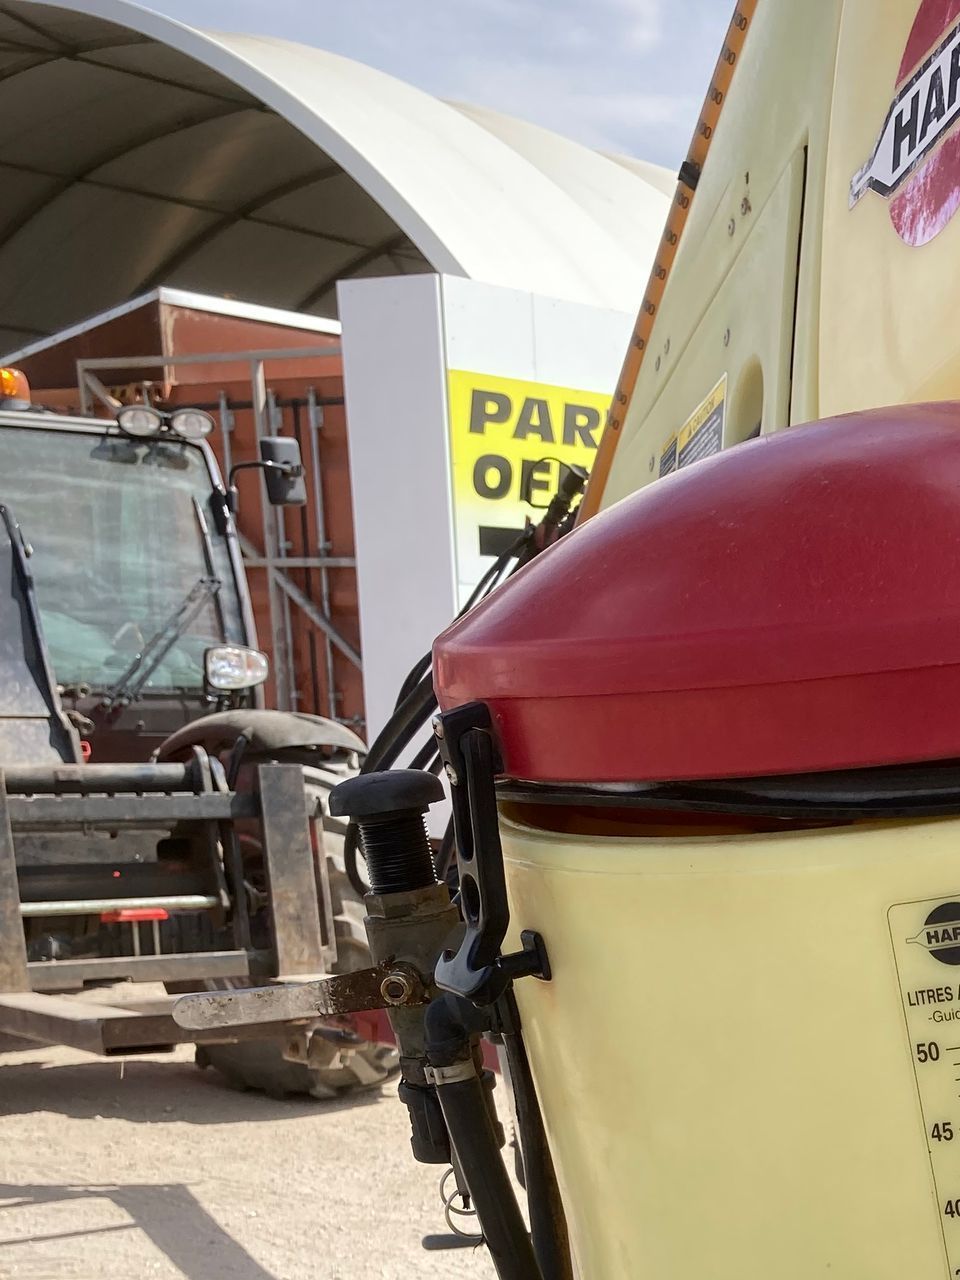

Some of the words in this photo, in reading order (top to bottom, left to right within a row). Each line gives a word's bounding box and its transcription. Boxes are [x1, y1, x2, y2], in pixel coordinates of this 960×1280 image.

[469, 388, 612, 449] PAR
[907, 986, 954, 1007] LITRES
[958, 984, 960, 1000] /
[917, 1042, 939, 1063] 50
[932, 1122, 953, 1141] 45
